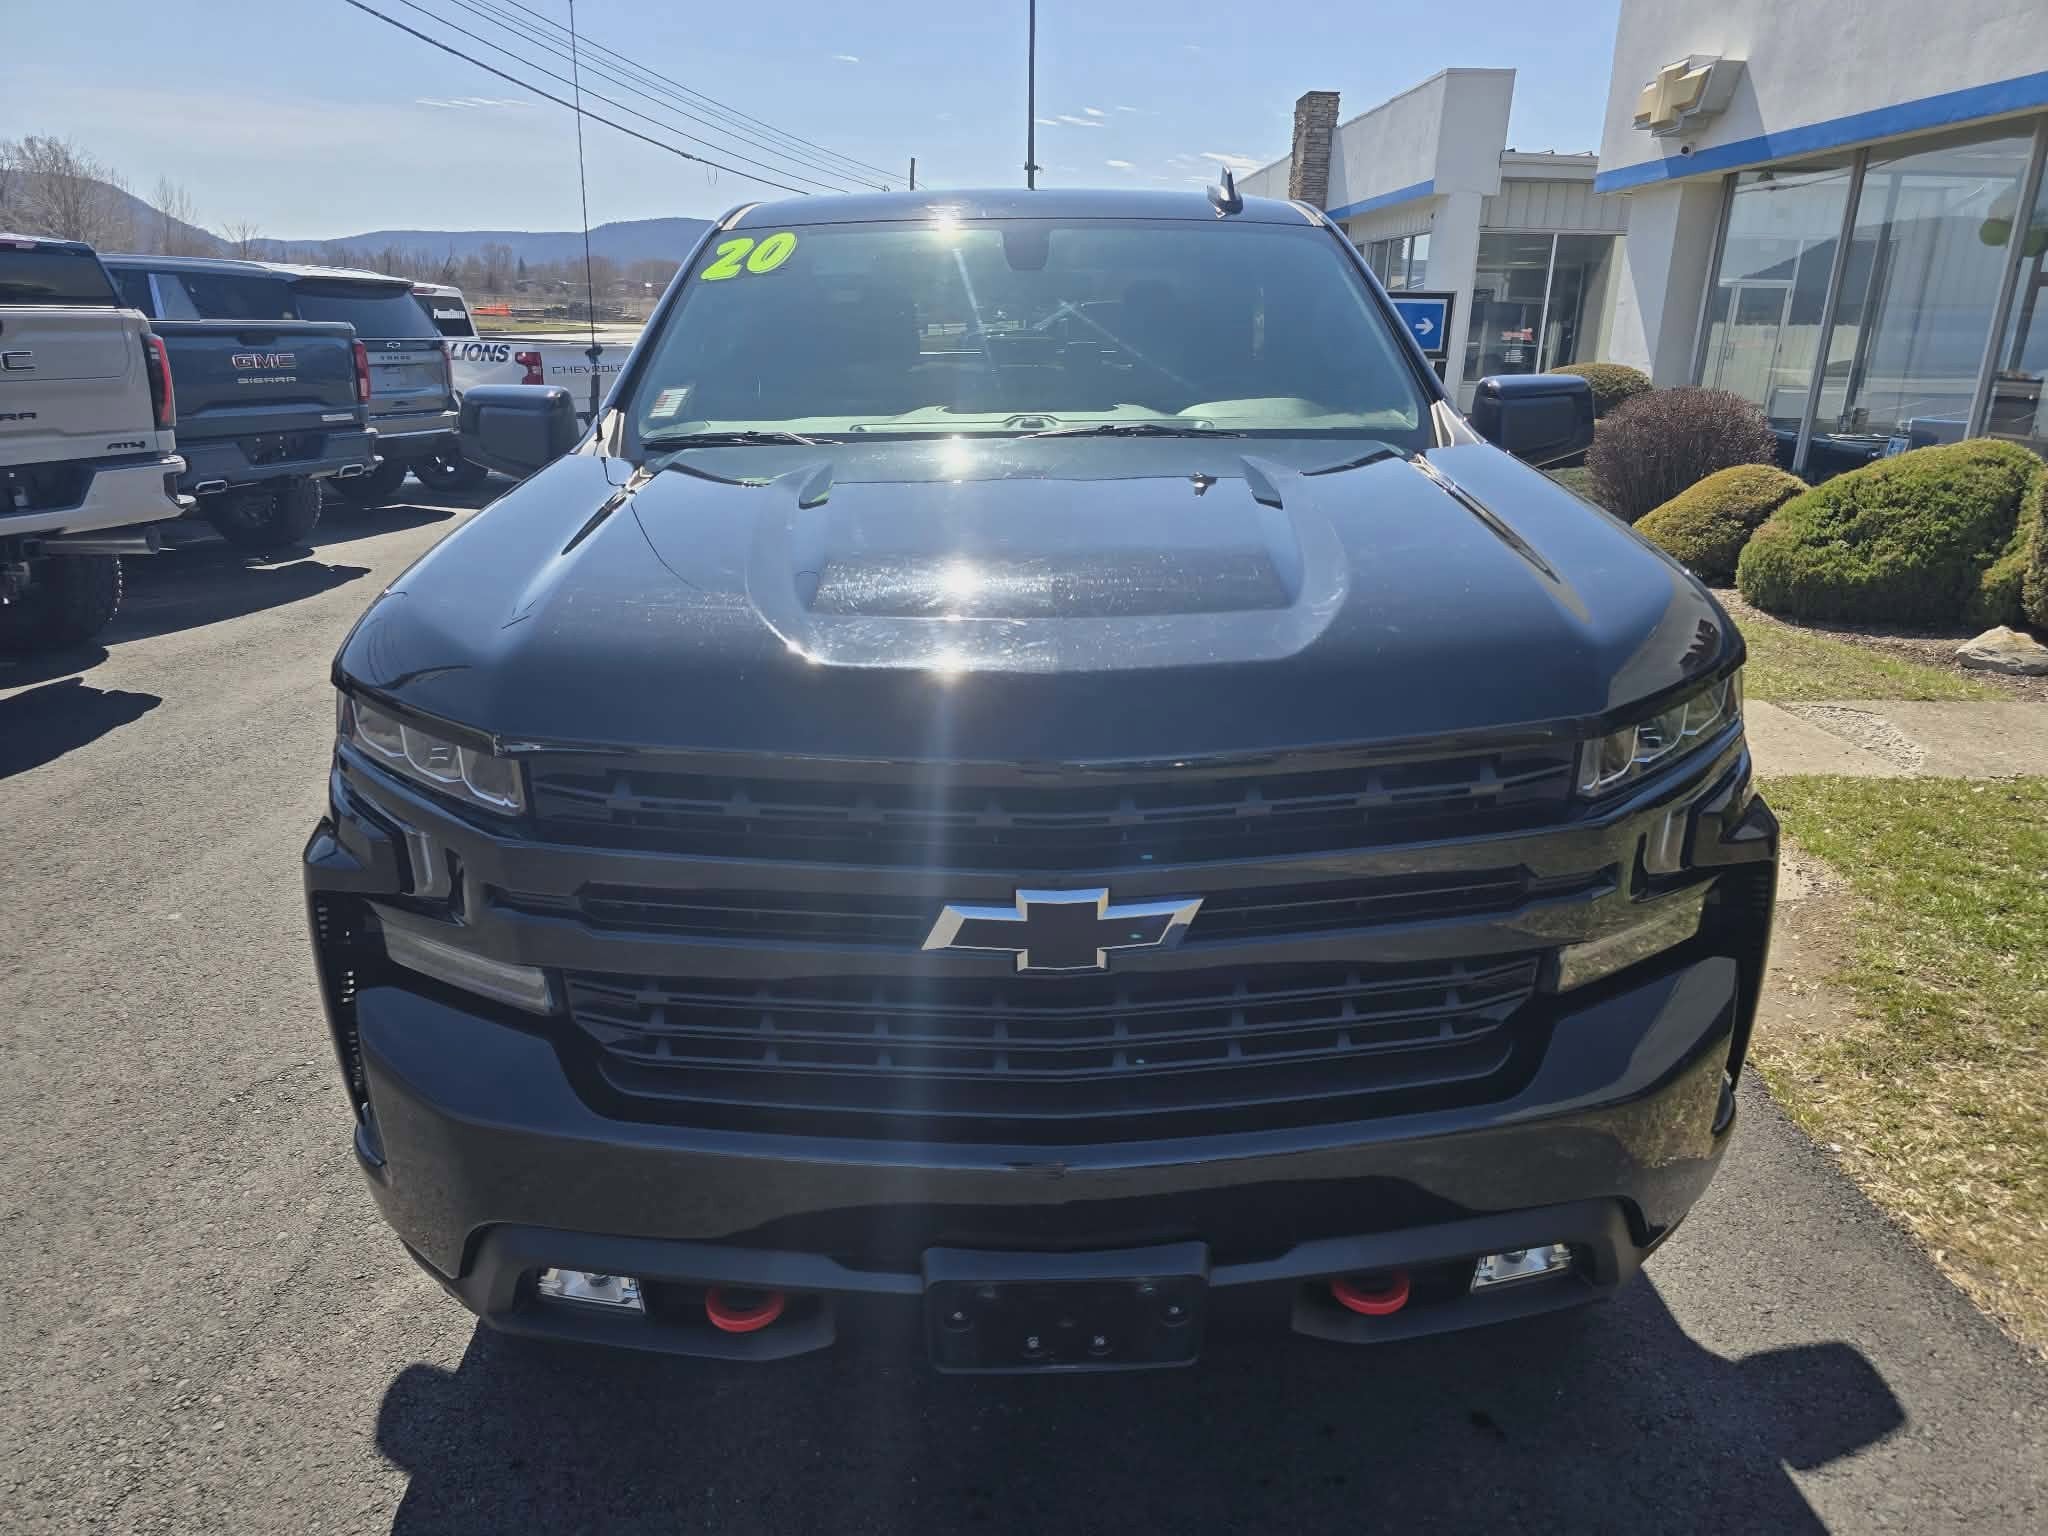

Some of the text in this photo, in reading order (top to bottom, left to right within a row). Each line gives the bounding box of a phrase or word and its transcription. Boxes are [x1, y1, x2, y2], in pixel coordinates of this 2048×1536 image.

[700, 232, 798, 280] 20
[231, 352, 297, 369] GMC
[237, 376, 297, 384] SIERRA
